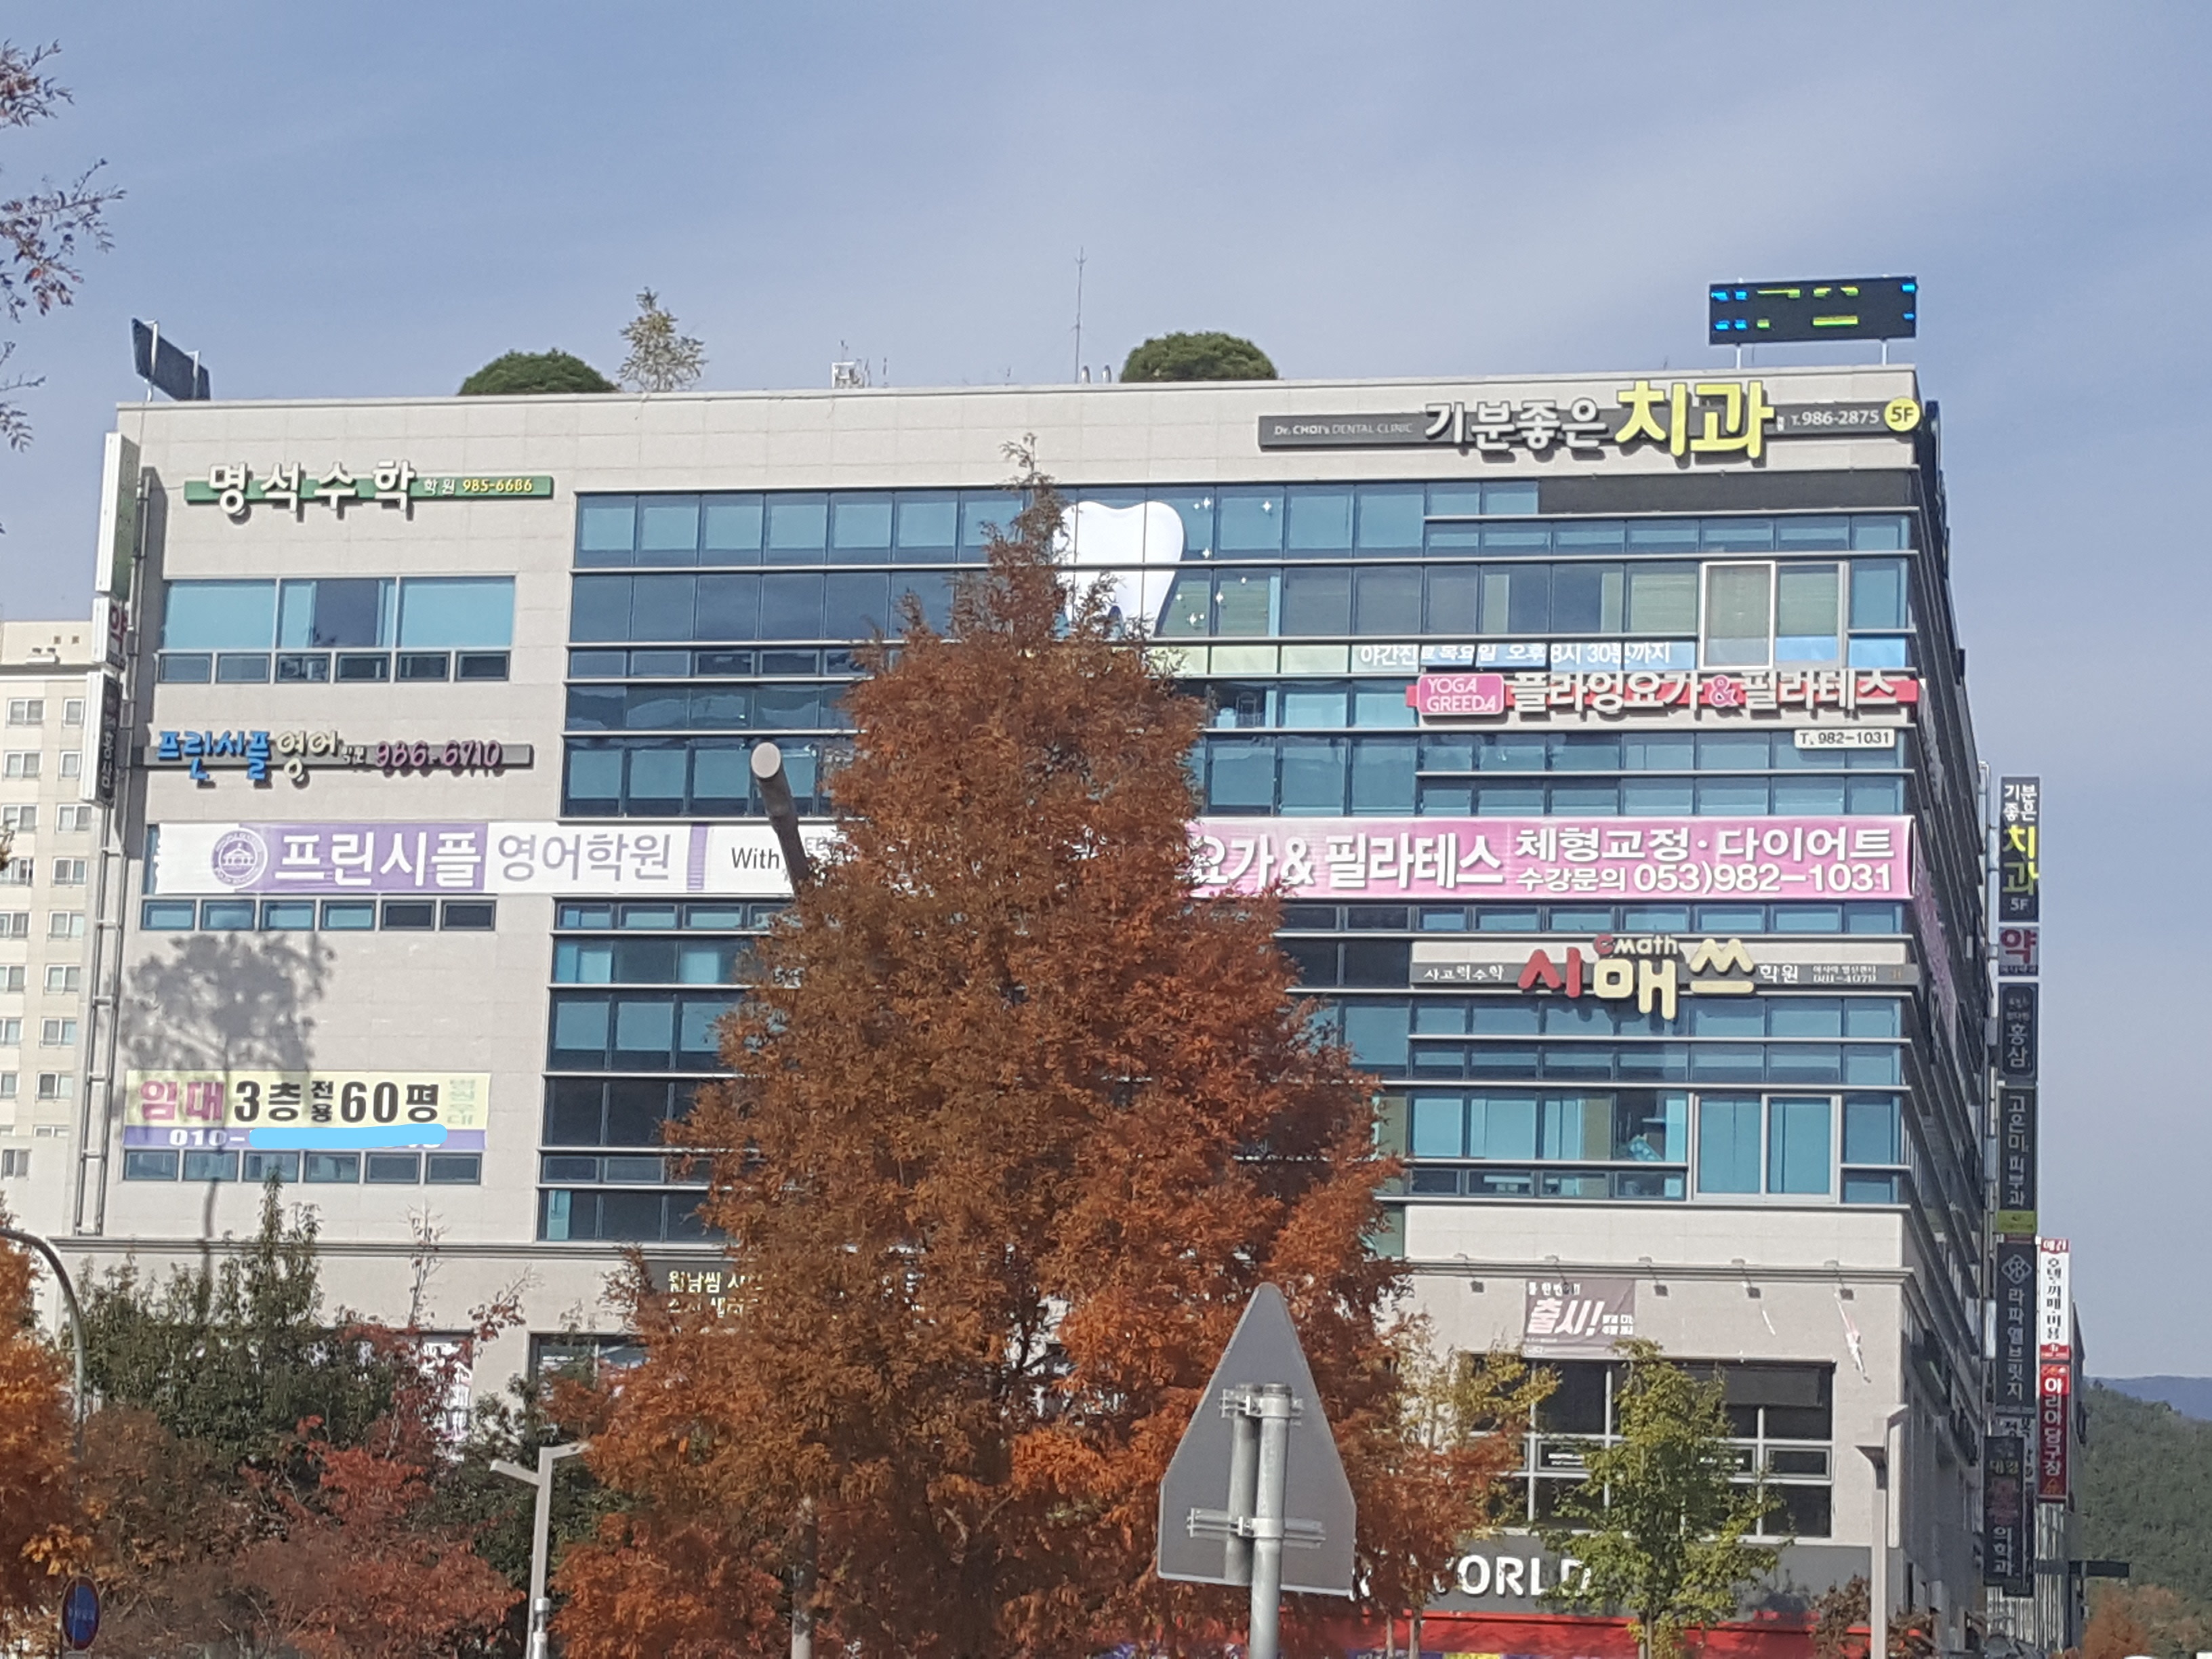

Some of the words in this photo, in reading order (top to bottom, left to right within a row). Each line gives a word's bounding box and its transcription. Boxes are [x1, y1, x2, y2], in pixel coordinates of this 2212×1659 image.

[1332, 424, 1374, 434] DENTAL
[1376, 423, 1413, 434] CLINIC
[1425, 397, 1607, 451] 기분좋은
[1614, 380, 1775, 458] 치과
[1890, 407, 1914, 423] 5F
[208, 460, 415, 515] 명석수학
[424, 478, 456, 495] 학원
[1505, 644, 1546, 661] 오후
[1551, 644, 1581, 665] 8시
[1427, 695, 1496, 712] GREEDA
[1428, 677, 1477, 693] YOGA
[274, 831, 481, 886] 프린시플
[497, 833, 671, 882] 영어학원
[731, 847, 780, 869] With
[1325, 832, 1504, 888] 필라테스
[2002, 825, 2039, 897] 치과
[1515, 867, 1626, 893] 수강문의
[1633, 861, 1892, 895] 053)982-1031
[2010, 898, 2029, 911] 5F
[2001, 928, 2037, 964] 약
[1517, 938, 1756, 1020] 시매쓰
[1759, 964, 1799, 983] 학원
[2007, 1023, 2028, 1068] 홍삼
[140, 1080, 224, 1121] 임대
[234, 1080, 301, 1122] 3층
[341, 1081, 439, 1123] 60평
[1527, 1297, 1605, 1336] 출시!
